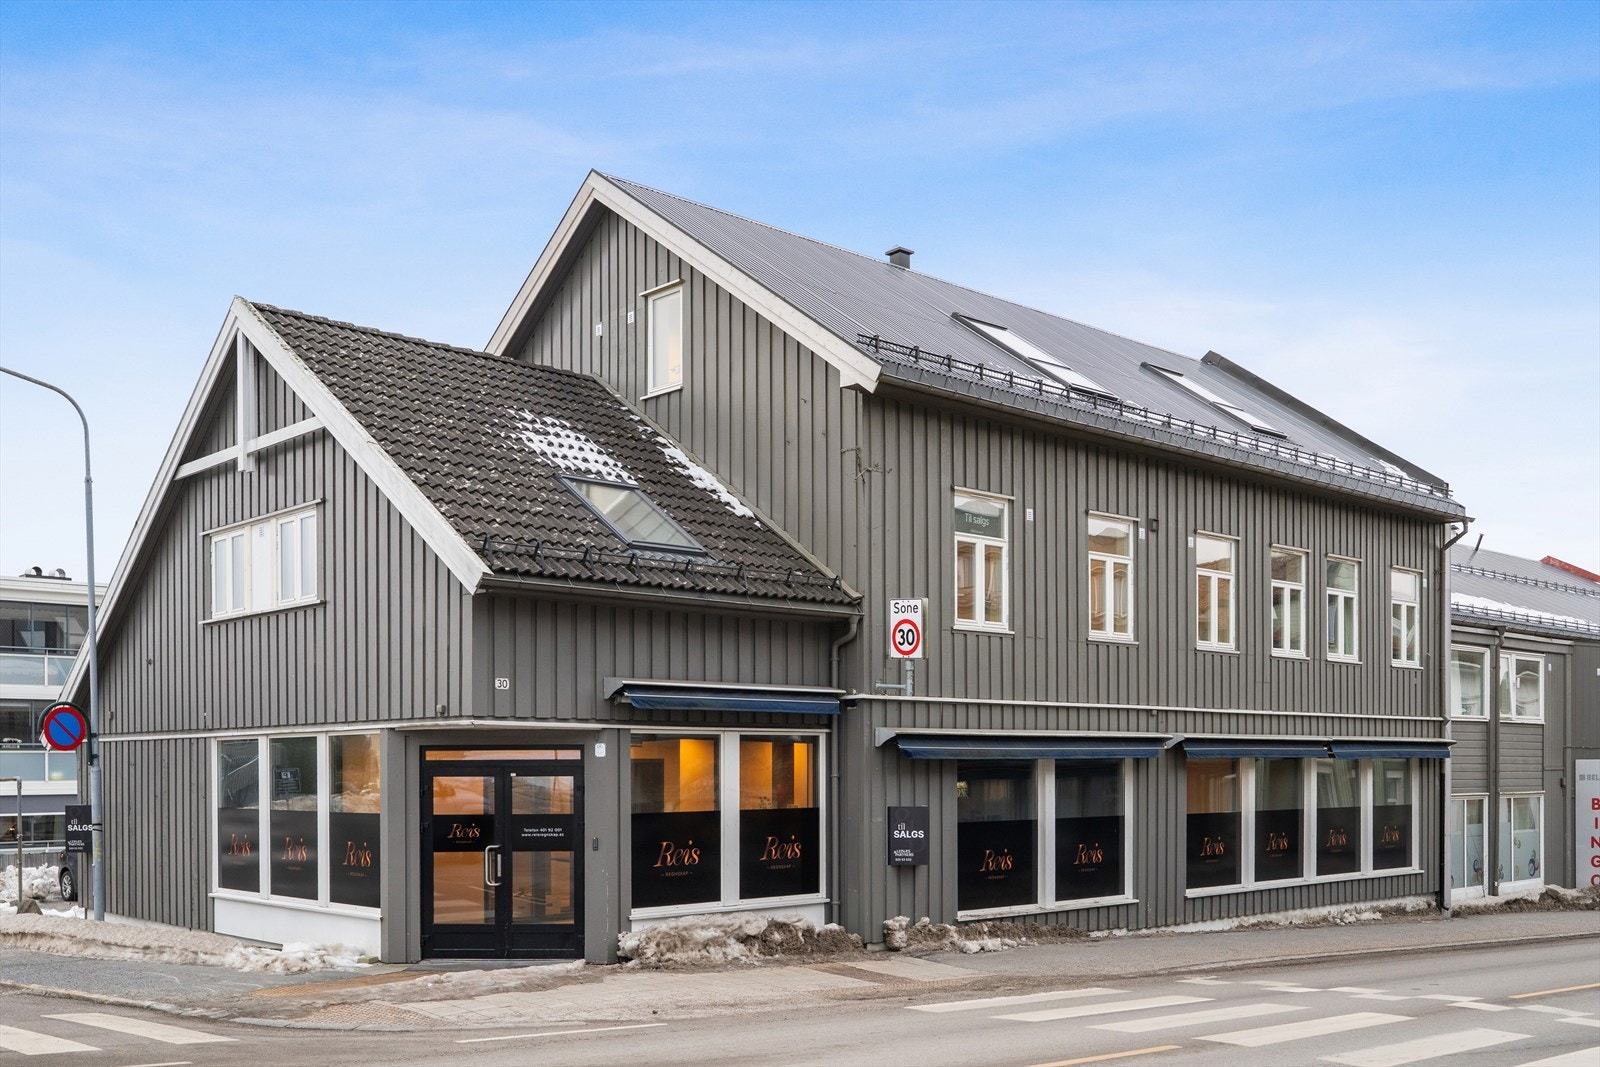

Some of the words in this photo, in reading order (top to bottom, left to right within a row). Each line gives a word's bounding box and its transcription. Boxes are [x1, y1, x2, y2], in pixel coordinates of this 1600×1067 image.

[973, 516, 990, 527] salgs
[894, 602, 918, 614] Sone
[898, 628, 914, 646] 30
[497, 679, 508, 688] 30
[448, 824, 480, 838] Reis
[1266, 832, 1288, 850] Reis
[228, 834, 250, 856] Reis
[282, 837, 307, 862] Reis
[342, 841, 372, 868] Reis
[653, 840, 700, 867] Reis
[760, 834, 802, 861] Reis
[1074, 843, 1103, 864] Reis
[1200, 837, 1224, 856] Reis
[980, 849, 1012, 871] Reis
